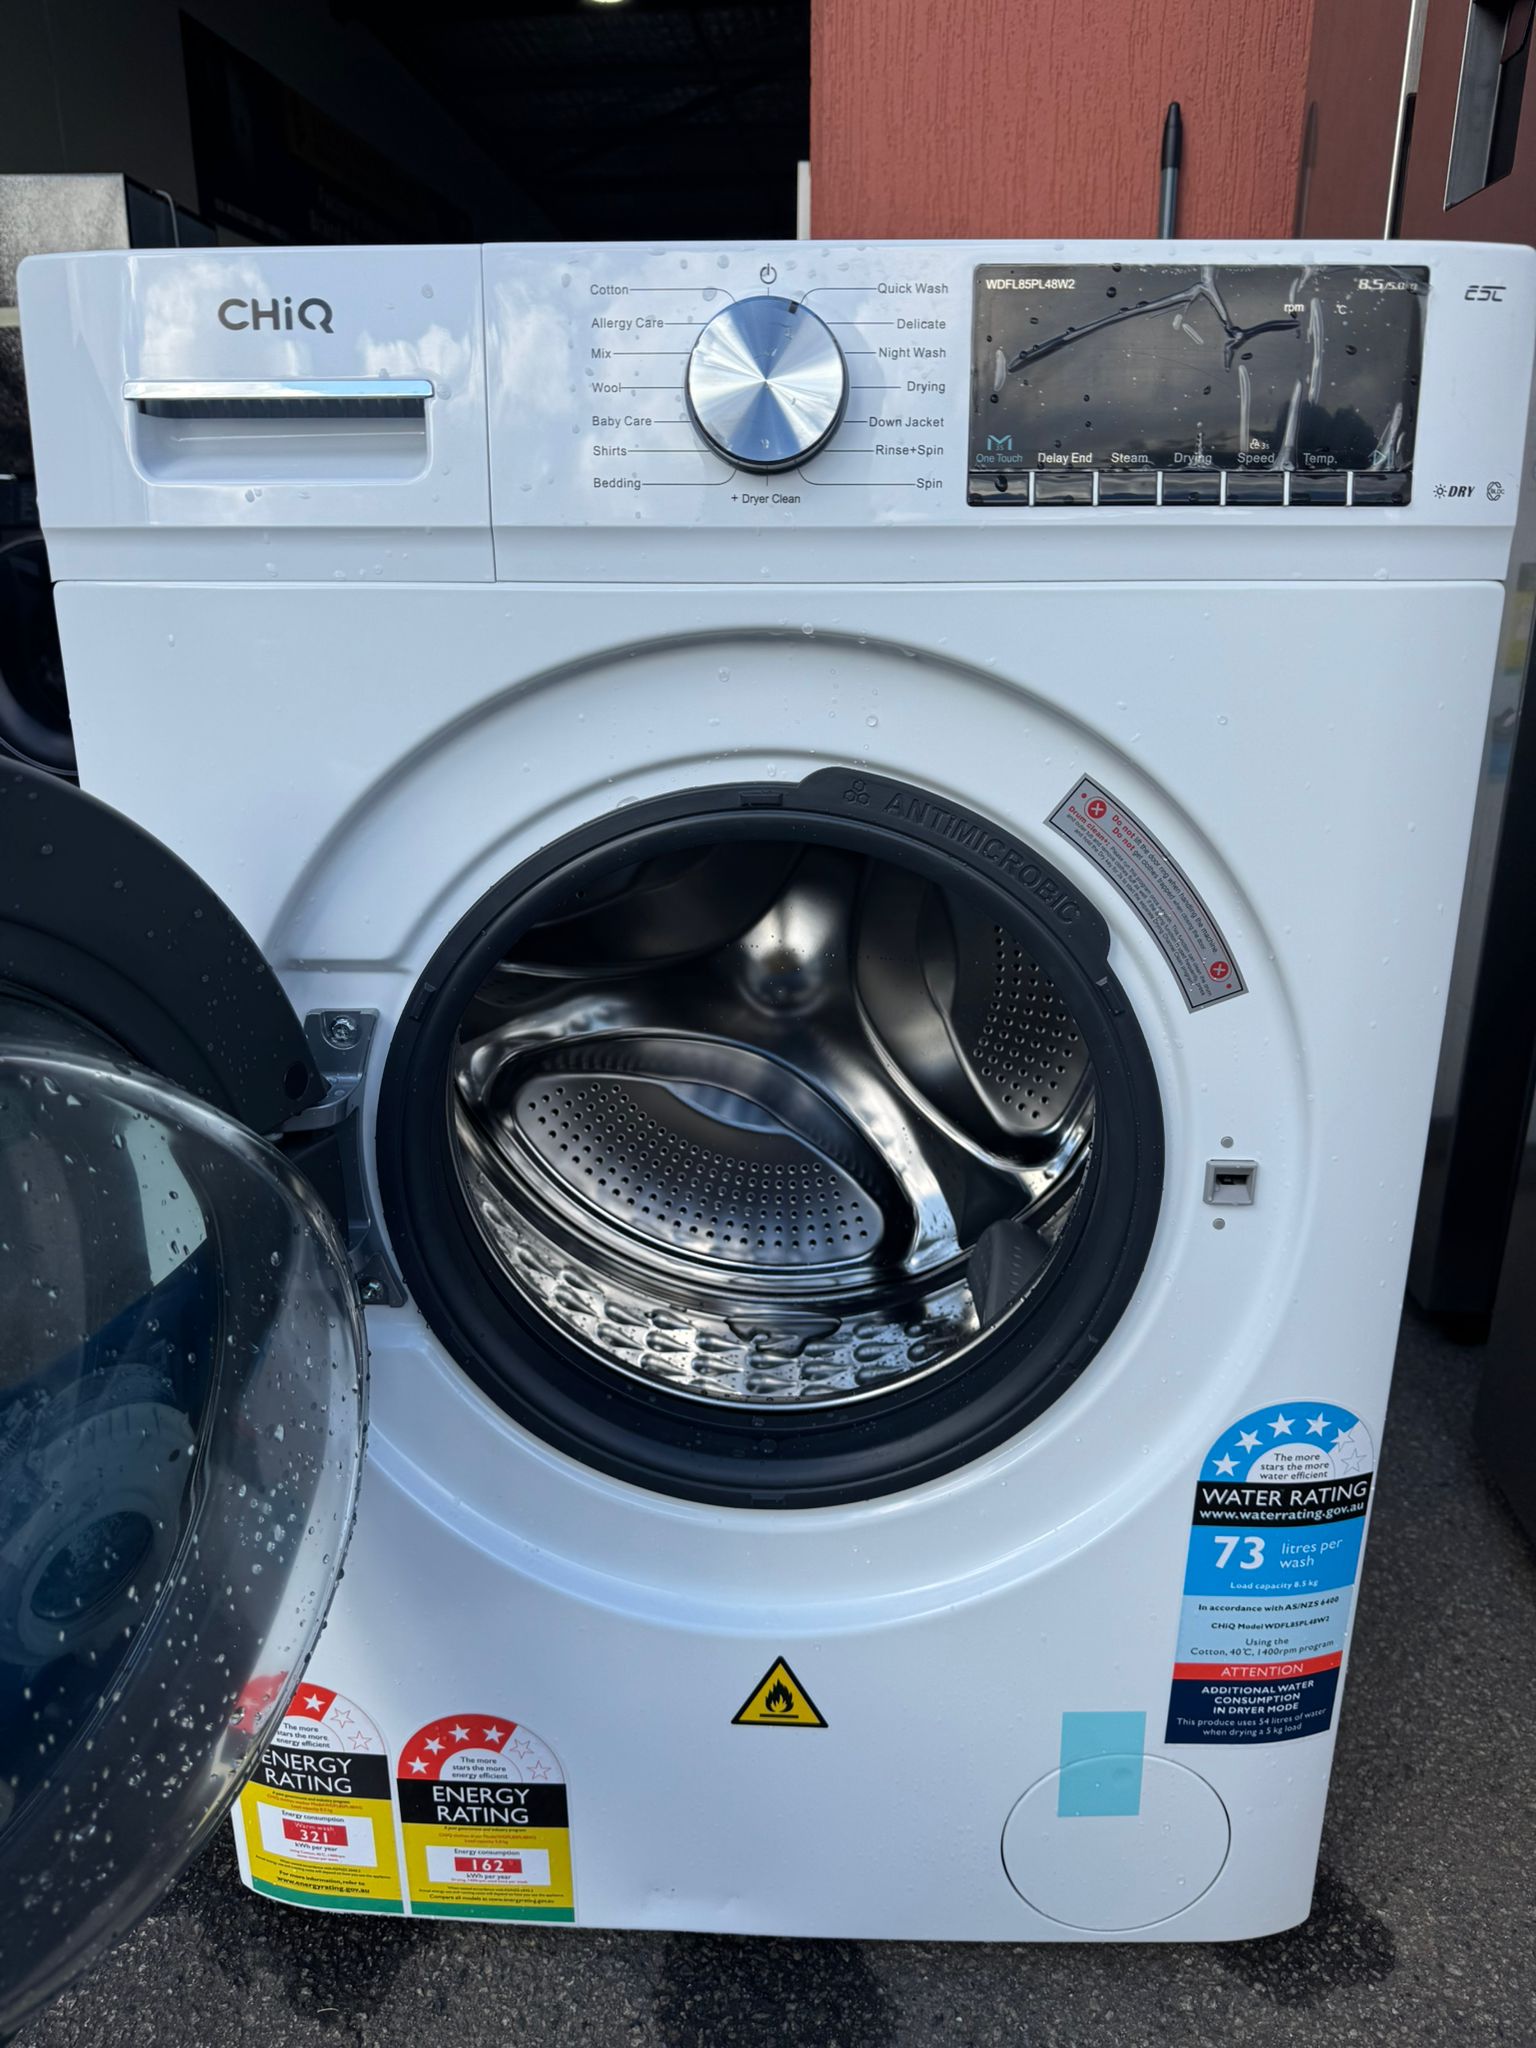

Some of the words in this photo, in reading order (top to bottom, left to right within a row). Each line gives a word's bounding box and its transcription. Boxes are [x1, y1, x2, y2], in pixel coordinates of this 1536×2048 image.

[590, 285, 628, 295] Cotton
[878, 283, 912, 294] Quick
[916, 283, 948, 293] Wash
[986, 279, 1075, 289] WDFL85PL48W2
[1284, 303, 1304, 312] rpm
[218, 296, 334, 333] CHiQ
[592, 318, 634, 330] Allergy
[636, 318, 663, 328] Care
[897, 319, 946, 329] Delicate
[592, 349, 611, 359] Mix
[879, 348, 912, 360] Night
[914, 348, 946, 358] Wash
[592, 383, 621, 392] Wool
[907, 381, 945, 393] Drying
[592, 416, 623, 427] Baby
[625, 416, 651, 425] Care
[869, 417, 902, 427] Down
[906, 417, 944, 427] Jacket
[593, 446, 627, 456] Shirts
[876, 445, 943, 457] Rinse+Spin
[976, 454, 994, 463] One
[997, 453, 1023, 463] Touch
[1038, 452, 1069, 465] Delay
[1071, 452, 1093, 463] End
[1111, 453, 1148, 463] Steam
[1174, 453, 1212, 465] Drying
[1237, 452, 1275, 465] Speed
[1303, 453, 1337, 465] Temp.
[593, 478, 641, 490] Bedding
[917, 478, 942, 490] Spin
[1448, 486, 1475, 497] DRY
[742, 493, 769, 506] Dryer
[772, 493, 800, 503] Clean
[1068, 806, 1088, 825] Drum
[1112, 827, 1123, 838] Do
[1122, 837, 1136, 851] not
[883, 793, 1080, 924] ANTIMICROBIC
[1112, 814, 1124, 826] Do
[1122, 825, 1136, 839] not
[1148, 853, 1162, 867] door
[1158, 867, 1169, 879] ring
[1167, 878, 1181, 894] when
[1177, 893, 1199, 918] handling
[1201, 928, 1218, 953] machine
[1274, 1453, 1292, 1461] The
[1291, 1471, 1327, 1479] efficient
[1202, 1488, 1282, 1507] WATER
[1290, 1481, 1368, 1506] RATING
[1200, 1502, 1364, 1521] www.waterrating.gov.au
[1282, 1540, 1316, 1554] litres
[1320, 1538, 1343, 1553] per
[1214, 1536, 1265, 1570] 73
[1280, 1556, 1314, 1568] wash
[1255, 1582, 1292, 1590] capacity
[1294, 1580, 1307, 1588] 8.5
[1285, 1600, 1319, 1610] AS/NZS
[1191, 1648, 1228, 1656] Cotton,
[1299, 1640, 1334, 1653] program
[1245, 1638, 1272, 1647] Using
[1221, 1664, 1303, 1677] ATTENTION
[1201, 1686, 1275, 1694] ADDITIONAL
[1278, 1680, 1314, 1692] WATER
[1215, 1693, 1300, 1704] CONSUMPTION
[1229, 1706, 1265, 1714] DRYER
[1268, 1702, 1299, 1712] MODE
[1198, 1718, 1235, 1728] produce
[1271, 1715, 1292, 1724] litres
[1295, 1712, 1303, 1721] of
[1305, 1708, 1326, 1718] water
[283, 1722, 297, 1730] The
[1203, 1728, 1228, 1736] when
[1230, 1728, 1257, 1737] drying
[1273, 1726, 1283, 1735] kg
[1285, 1723, 1302, 1732] load
[276, 1738, 300, 1747] energy
[302, 1740, 330, 1748] efficient
[262, 1749, 352, 1774] ENERGY
[265, 1767, 352, 1794] RATING
[433, 1786, 530, 1805] ENERGY
[282, 1810, 302, 1819] Energy
[304, 1813, 344, 1823] consumption
[437, 1806, 529, 1824] RATING
[300, 1830, 328, 1843] 321
[294, 1842, 311, 1850] kWh
[454, 1848, 476, 1856] Energy
[472, 1859, 504, 1872] 162
[290, 1872, 305, 1880] more
[277, 1876, 370, 1894] www.energyrating.gov.au
